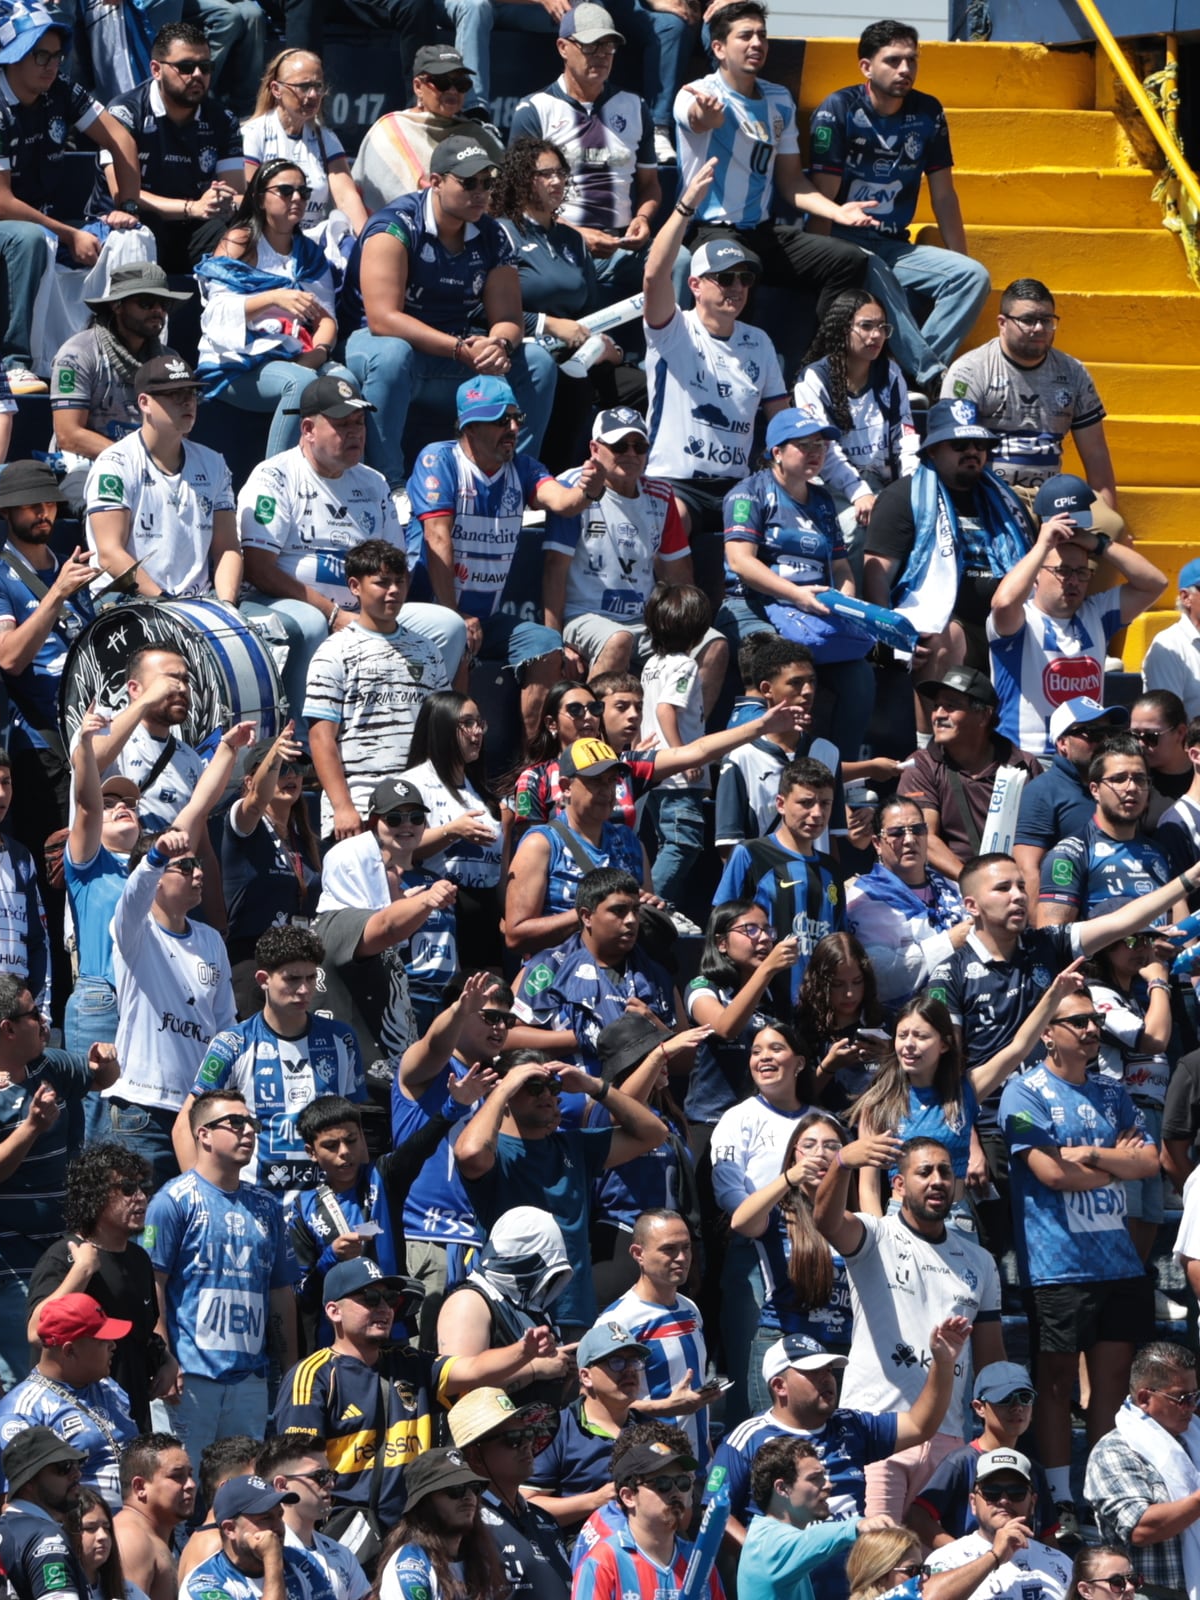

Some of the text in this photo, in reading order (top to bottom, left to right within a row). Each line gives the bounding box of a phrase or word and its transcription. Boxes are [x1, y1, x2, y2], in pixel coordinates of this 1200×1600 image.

[731, 420, 752, 434] INS
[1053, 495, 1078, 508] CPIC
[470, 572, 507, 585] HUAW
[291, 1165, 328, 1182] kölb
[921, 1264, 951, 1276] ATREVIA
[230, 1303, 262, 1338] BN
